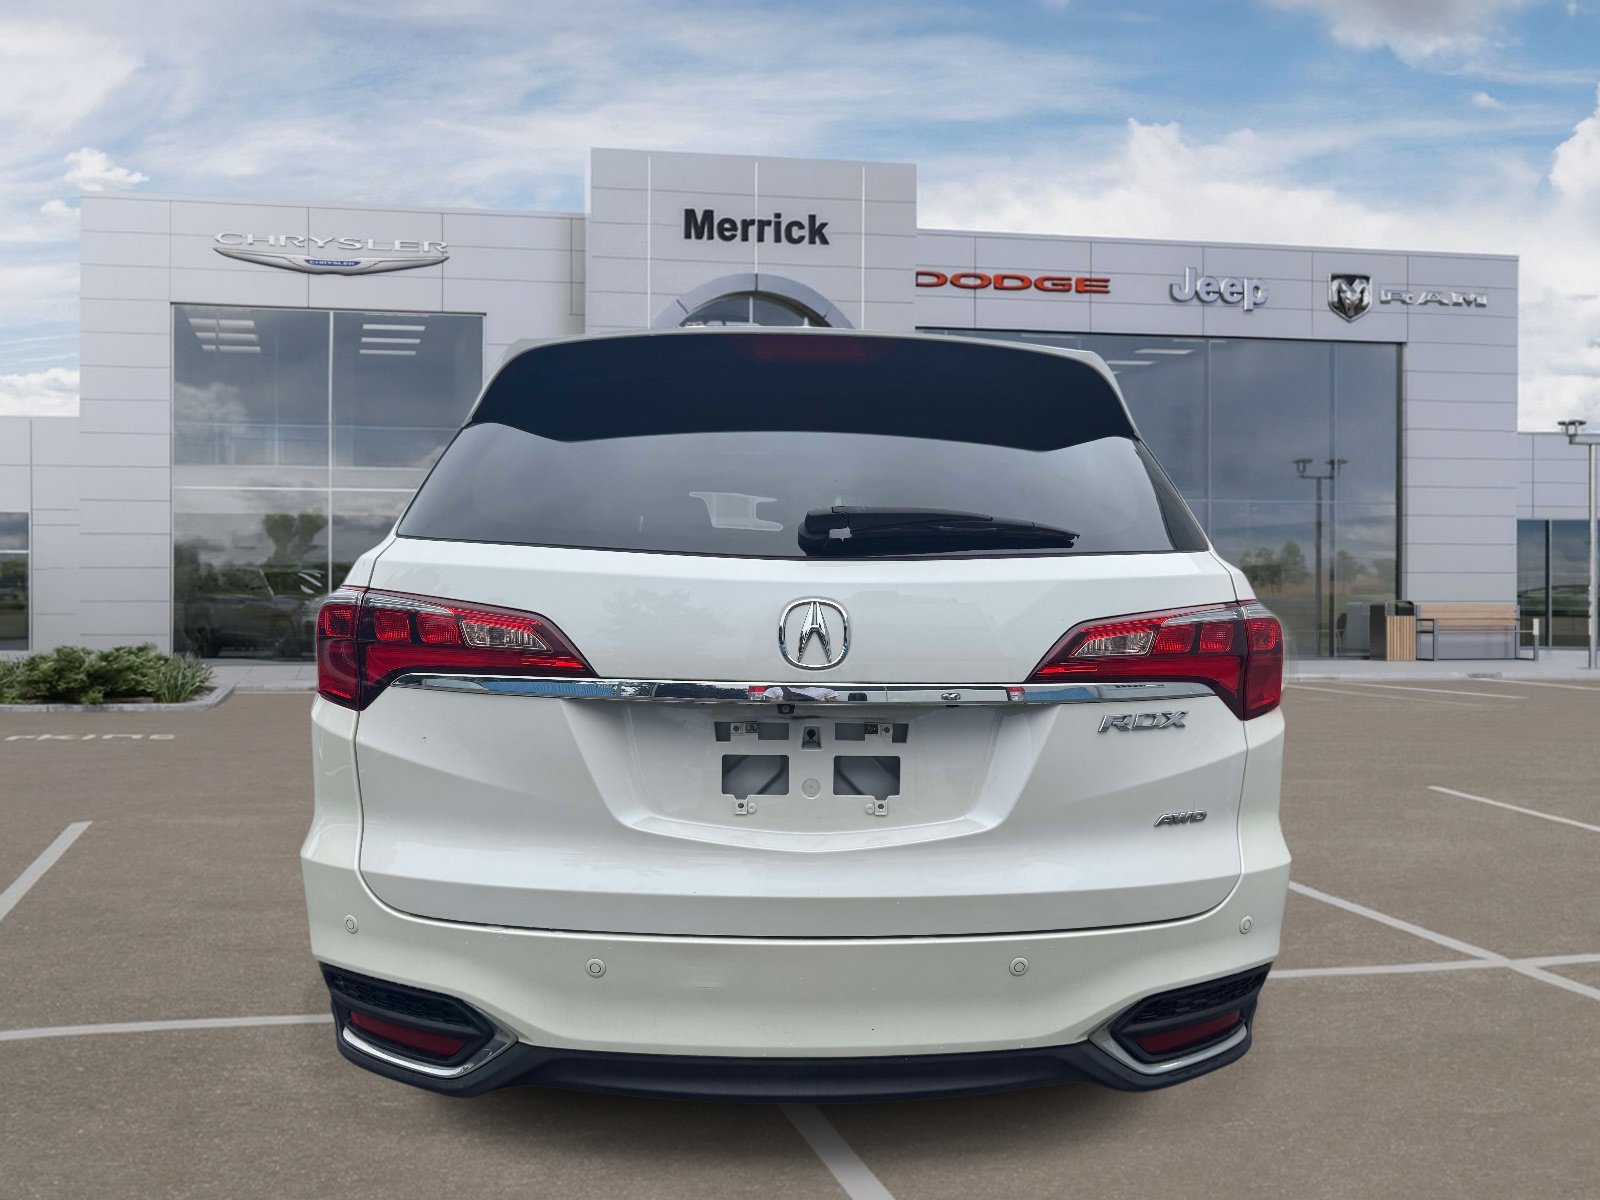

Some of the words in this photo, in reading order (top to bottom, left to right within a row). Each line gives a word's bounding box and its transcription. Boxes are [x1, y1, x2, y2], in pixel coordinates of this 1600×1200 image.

[684, 208, 830, 245] Merrick
[213, 232, 449, 253] CHRYSLER
[915, 271, 1111, 294] DODGE
[1169, 266, 1269, 311] Jeep
[1380, 289, 1488, 307] RAM
[1098, 711, 1188, 733] RDX
[1154, 810, 1207, 827] AWD
